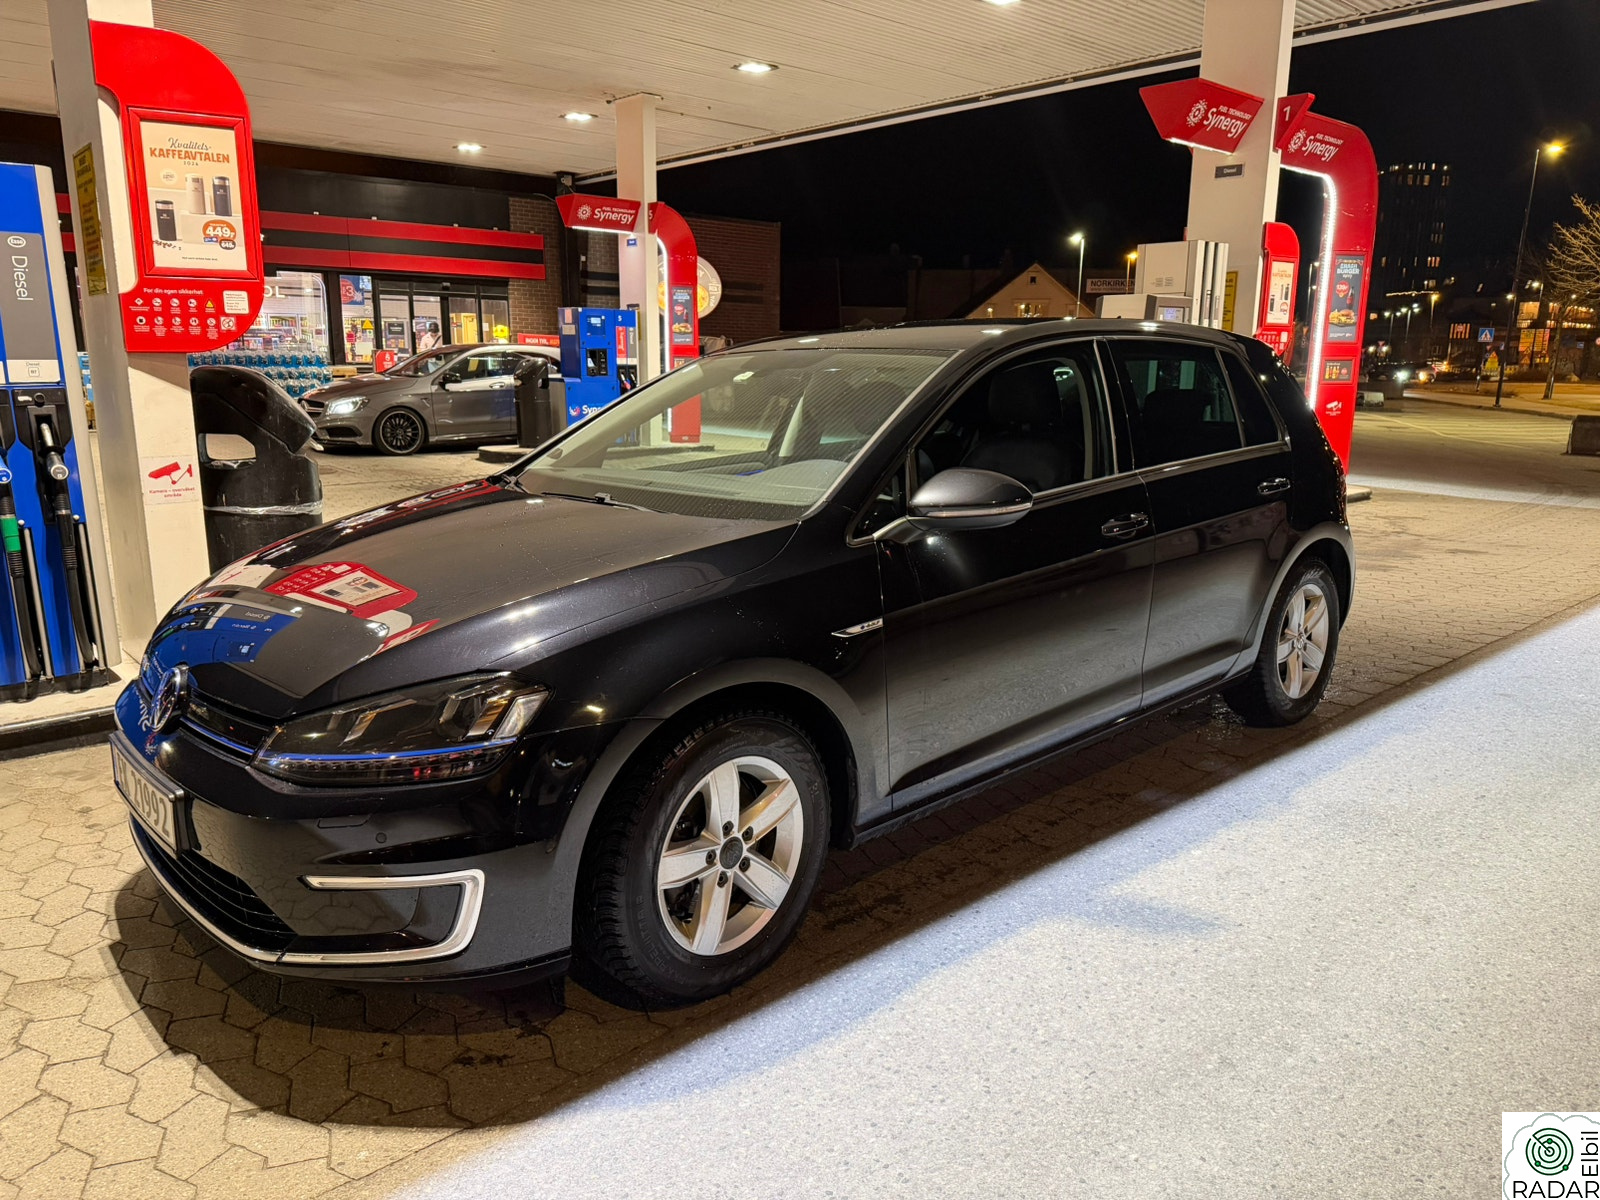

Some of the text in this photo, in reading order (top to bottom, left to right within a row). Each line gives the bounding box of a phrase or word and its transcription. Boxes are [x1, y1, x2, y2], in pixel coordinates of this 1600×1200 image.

[1218, 105, 1252, 120] FUEL TECHNOLOGY
[1283, 105, 1291, 121] 1
[1203, 108, 1247, 139] Synergy
[149, 147, 230, 164] KAFFEAVTALEN
[1302, 135, 1339, 162] Synergy
[593, 208, 635, 224] Synergy
[11, 255, 34, 301] Diesel
[582, 405, 605, 415] Syn
[131, 768, 171, 838] 21992
